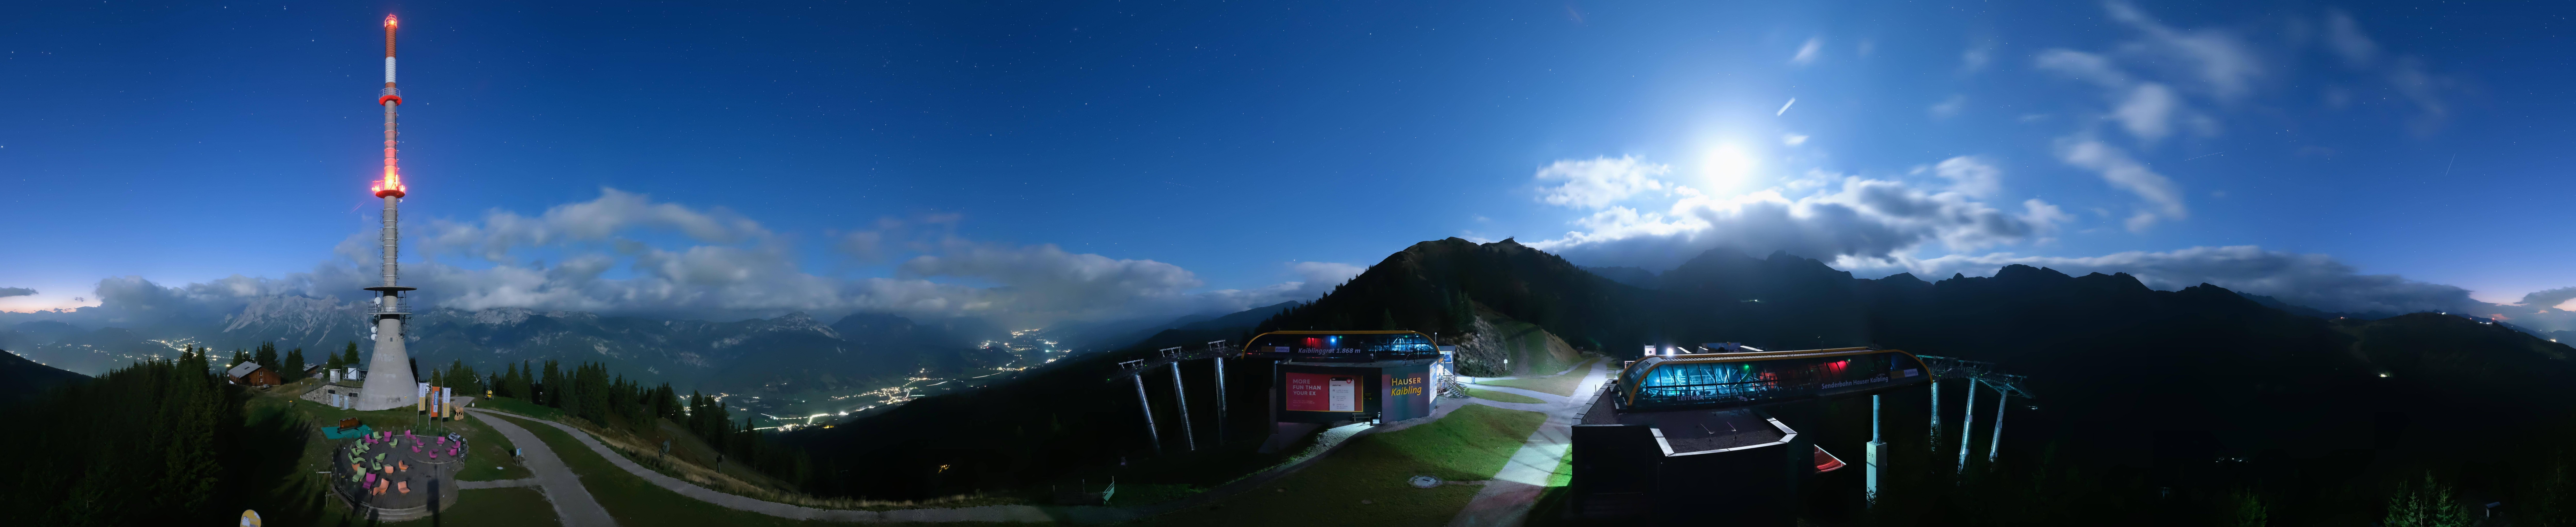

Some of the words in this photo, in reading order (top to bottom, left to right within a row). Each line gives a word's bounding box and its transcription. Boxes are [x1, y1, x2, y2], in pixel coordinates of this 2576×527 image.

[1391, 377, 1421, 386] HAUSER
[1822, 380, 1852, 389] Senderbahn
[1391, 386, 1422, 396] Kaibling
